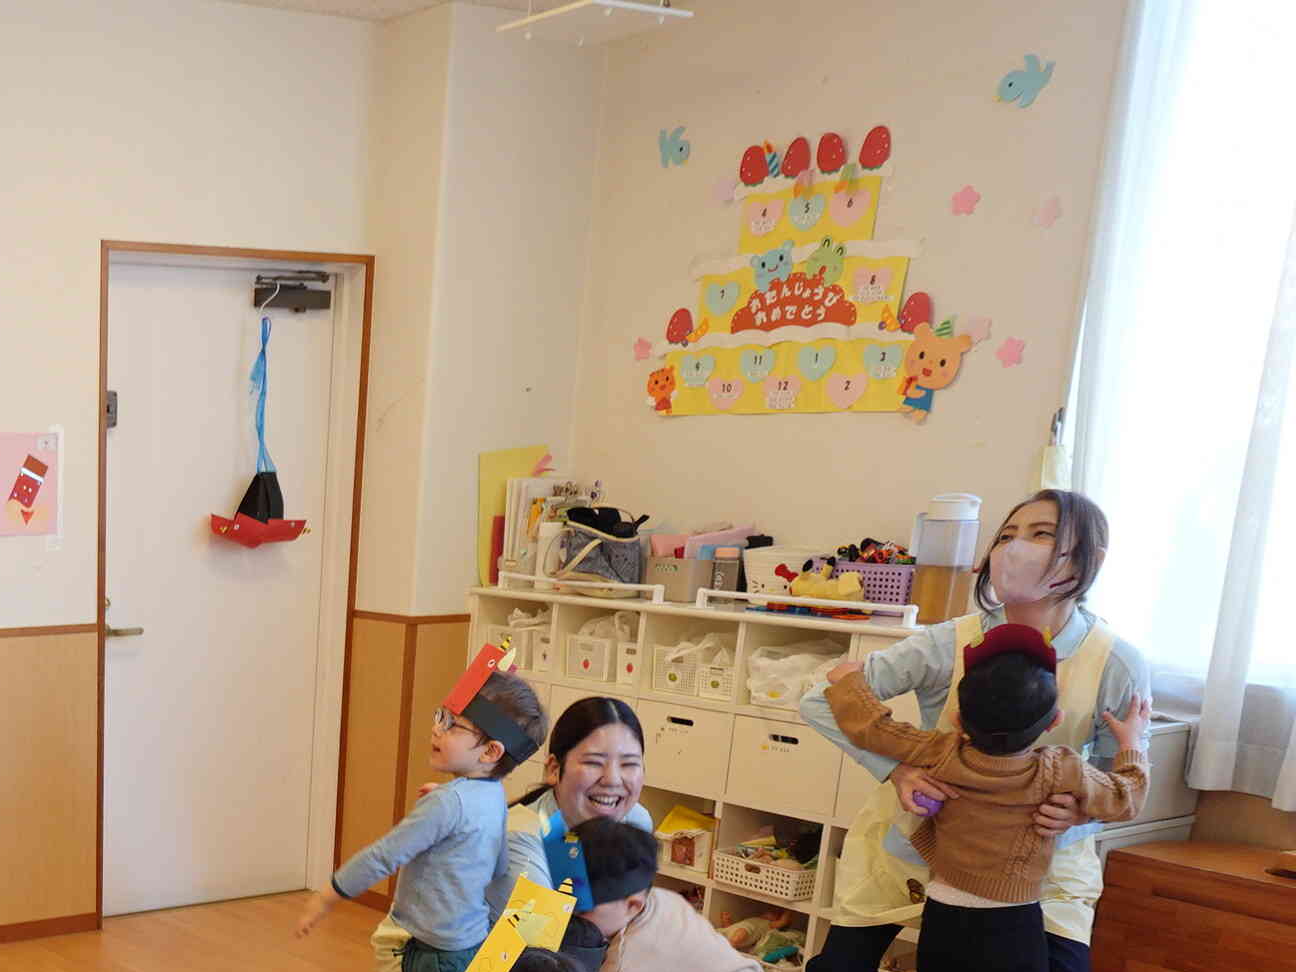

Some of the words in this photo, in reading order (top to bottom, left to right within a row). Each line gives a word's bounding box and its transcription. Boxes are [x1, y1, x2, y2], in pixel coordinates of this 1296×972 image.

[754, 304, 826, 326] おめでとう
[753, 355, 763, 365] 11
[721, 383, 732, 393] 10
[778, 381, 789, 391] 12
